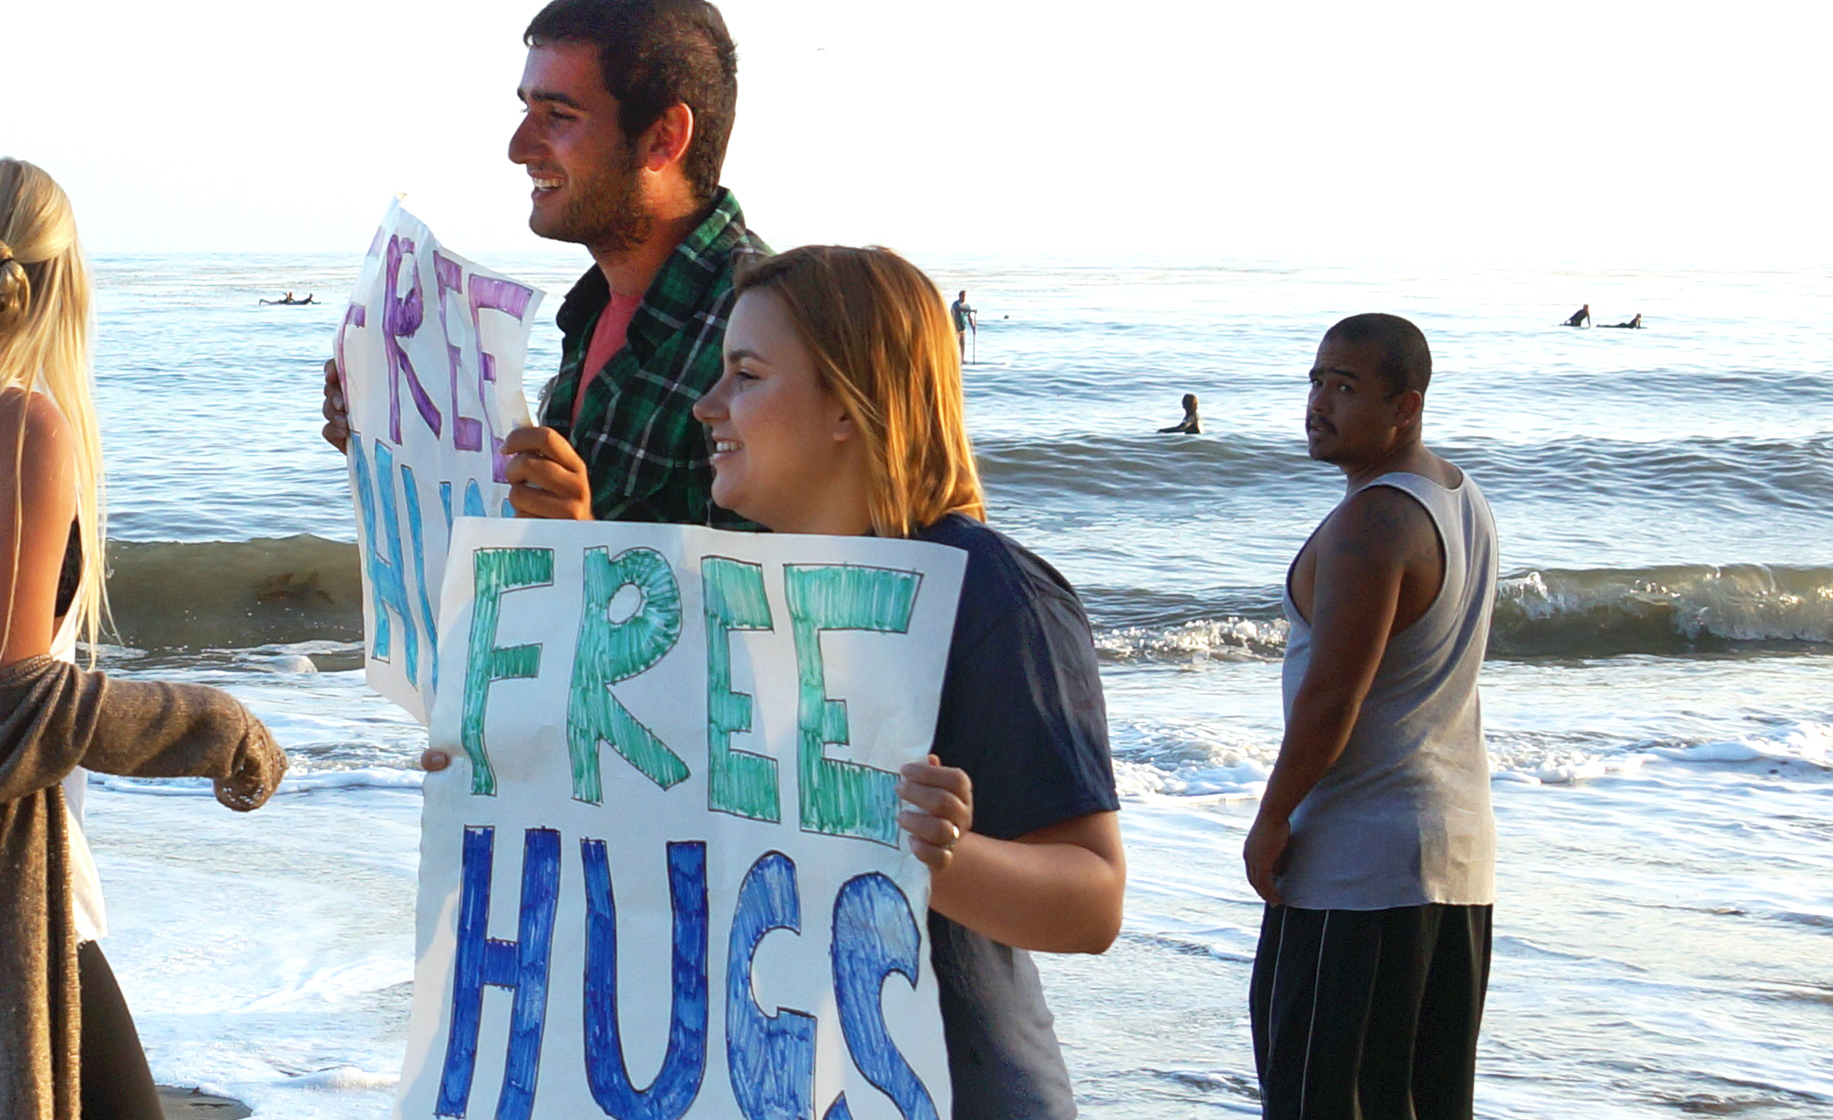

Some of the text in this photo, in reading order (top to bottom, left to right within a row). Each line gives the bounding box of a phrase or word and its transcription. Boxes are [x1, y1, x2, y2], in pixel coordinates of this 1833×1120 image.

[336, 225, 534, 485] FREE
[346, 430, 516, 695] HU
[461, 545, 924, 850] FREE
[434, 824, 940, 1120] HUGS
